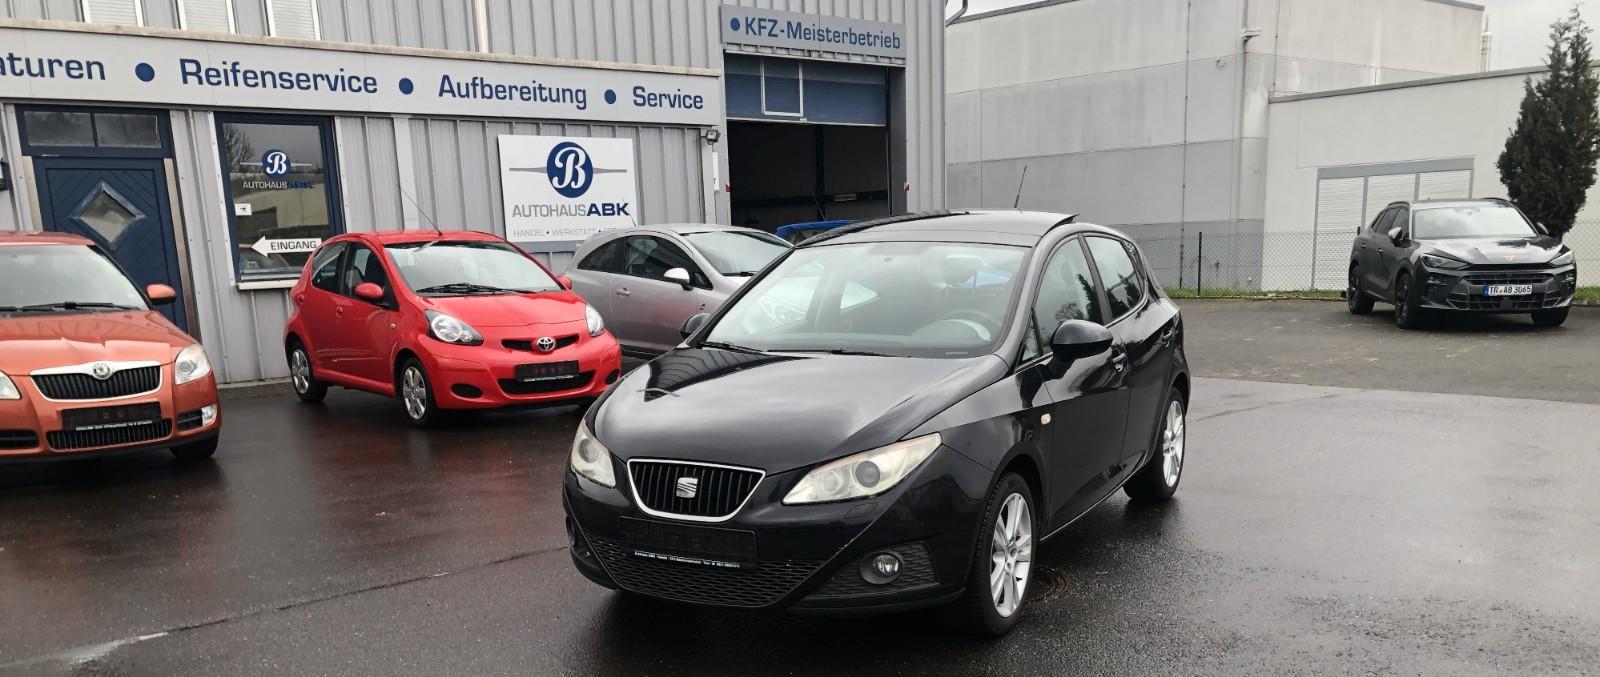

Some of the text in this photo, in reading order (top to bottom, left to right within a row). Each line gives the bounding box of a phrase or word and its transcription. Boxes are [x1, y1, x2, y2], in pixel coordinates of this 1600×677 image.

[744, 16, 901, 49] KFZ-Meisterbetrieb
[180, 58, 378, 94] Reifenservice
[438, 74, 587, 110] Aufbereitung
[632, 86, 704, 109] Service
[513, 228, 545, 237] HANDEL
[270, 240, 317, 251] EINGANG
[1489, 286, 1499, 294] TR
